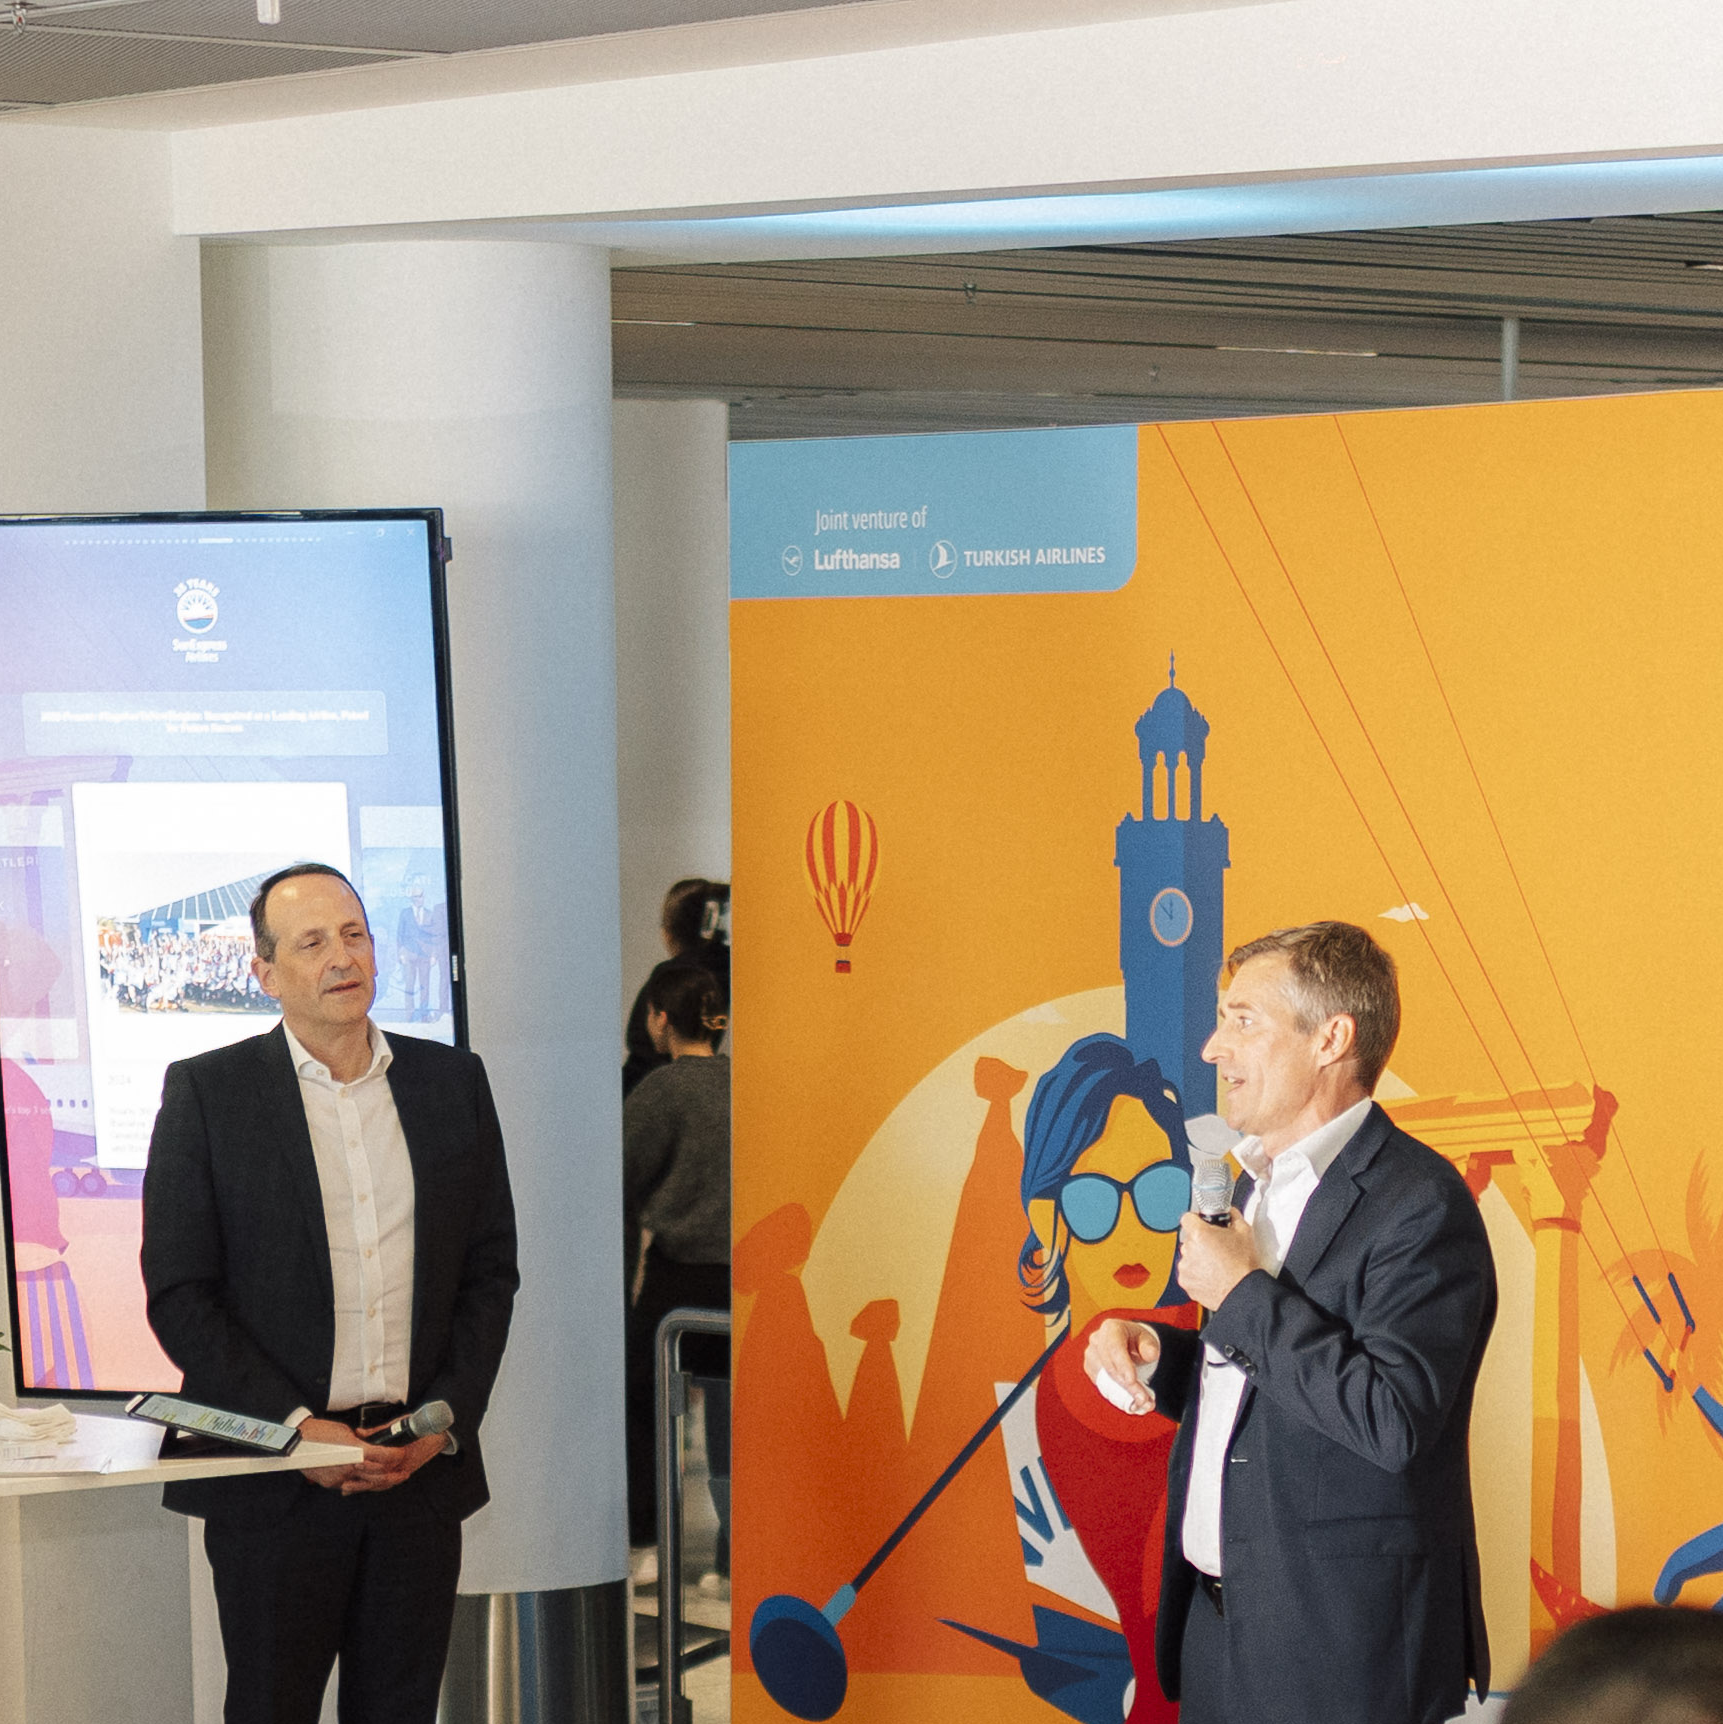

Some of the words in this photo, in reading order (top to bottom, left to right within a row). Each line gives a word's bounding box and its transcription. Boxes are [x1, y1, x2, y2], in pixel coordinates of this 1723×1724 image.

[814, 509, 848, 535] Joint
[852, 511, 907, 530] venture
[911, 505, 928, 528] of
[814, 549, 900, 570] Lufthansa
[964, 549, 1030, 567] TURKISH
[1035, 547, 1106, 565] AIRLINES
